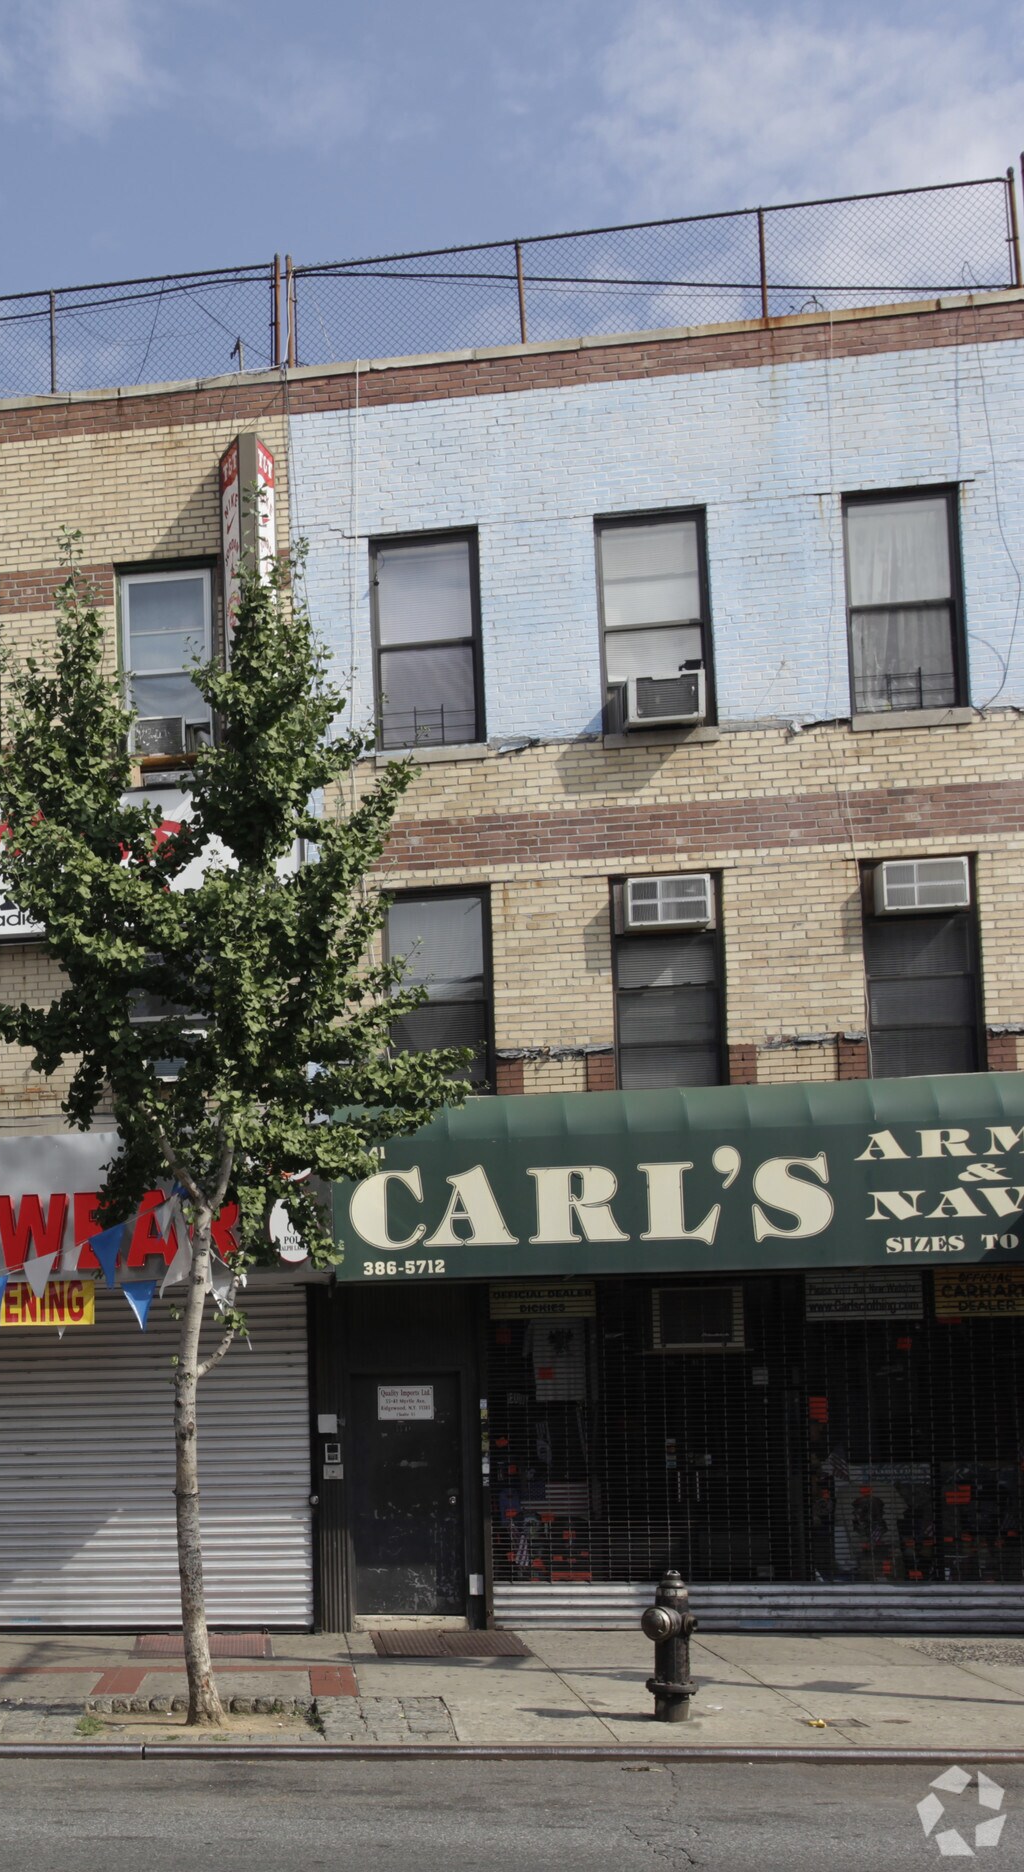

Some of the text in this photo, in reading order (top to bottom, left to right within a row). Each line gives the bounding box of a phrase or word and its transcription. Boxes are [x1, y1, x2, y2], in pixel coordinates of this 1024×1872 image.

[957, 1162, 1013, 1182] &
[349, 1144, 835, 1251] CARL'S
[885, 1233, 1020, 1254] SIZES TO
[363, 1258, 446, 1276] 386-5712
[958, 1271, 1013, 1283] OFFICIAL
[492, 1288, 592, 1299] OFFICIAL DEALER
[519, 1303, 566, 1313] DICKIES
[958, 1300, 1017, 1311] DEALER
[381, 1389, 399, 1398] Quality
[400, 1389, 420, 1398] Imports
